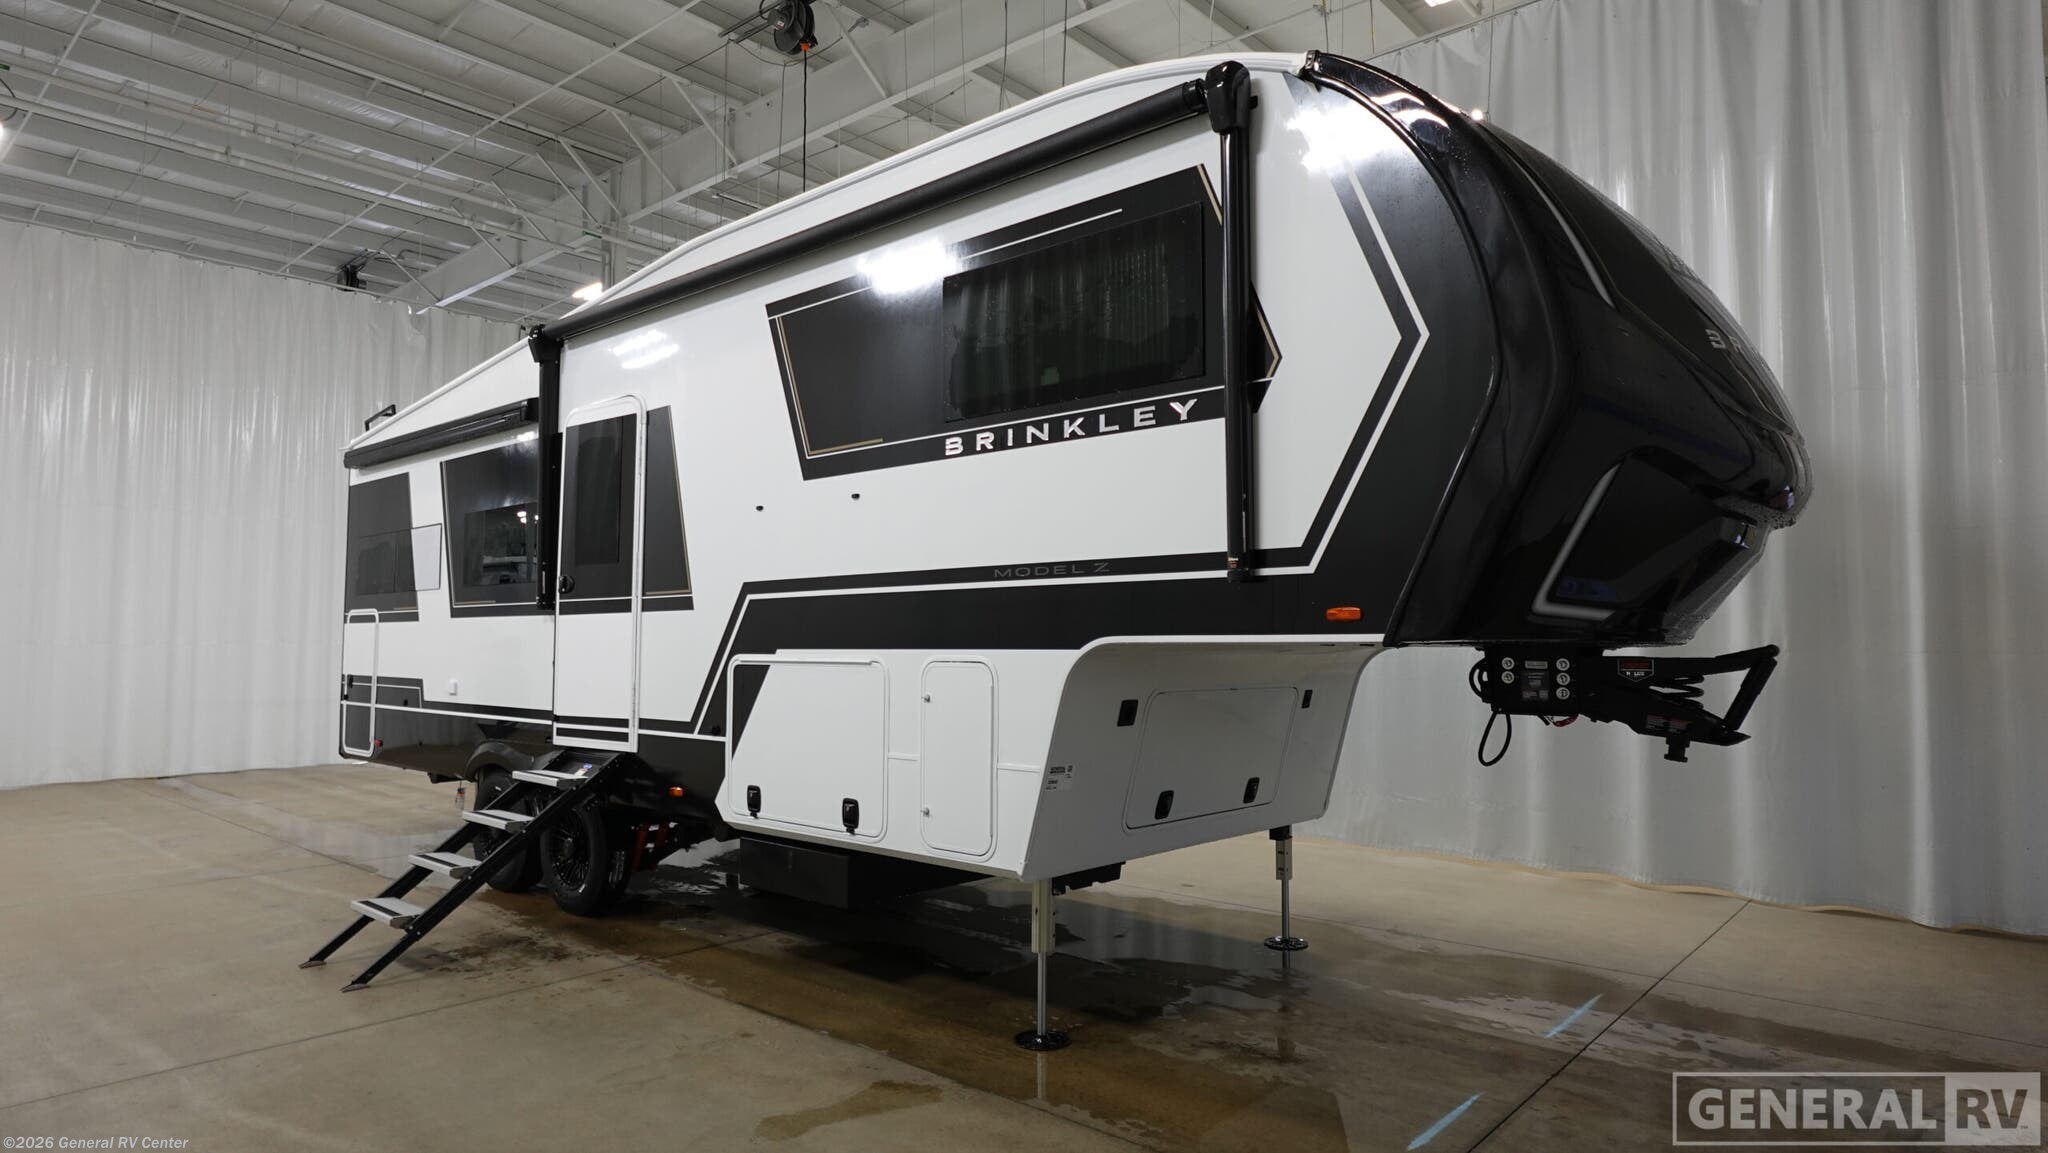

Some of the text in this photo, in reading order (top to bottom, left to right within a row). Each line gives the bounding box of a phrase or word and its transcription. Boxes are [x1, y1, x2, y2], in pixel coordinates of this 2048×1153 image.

[945, 398, 1198, 456] BRINKLEY
[993, 561, 1111, 578] MODEL Z
